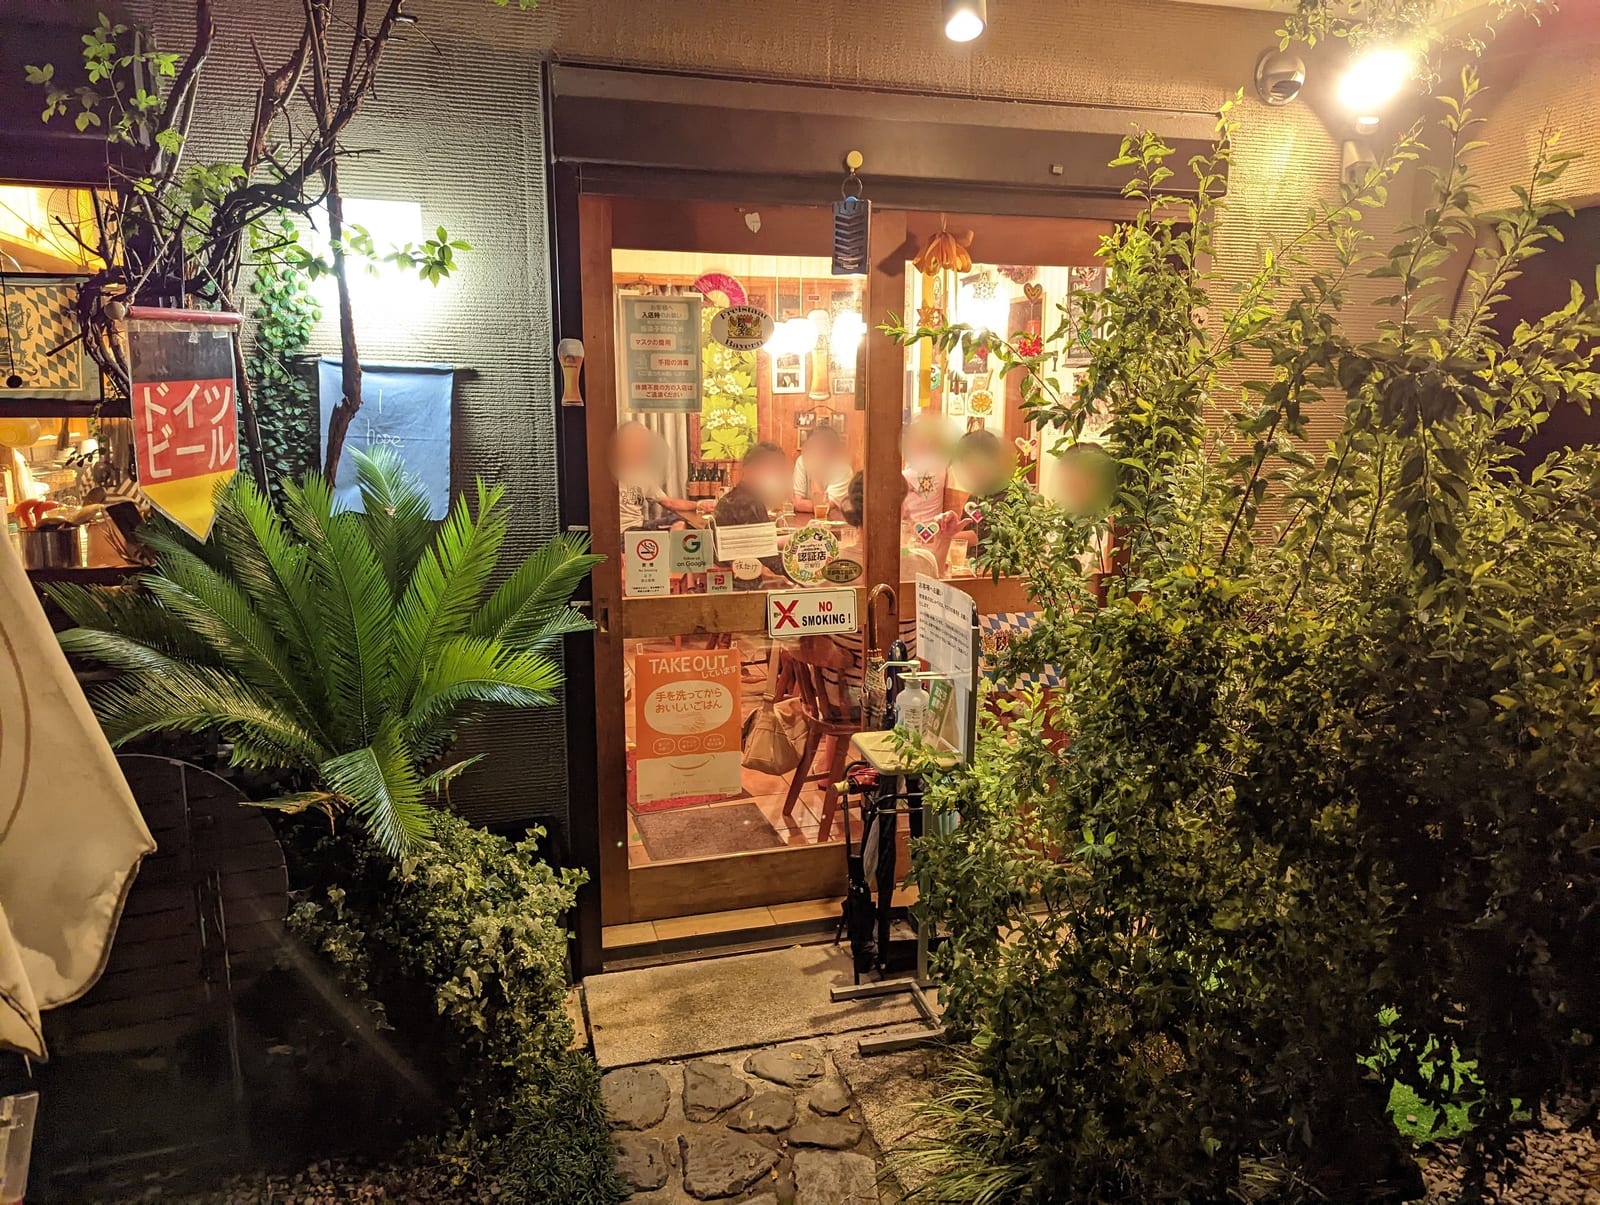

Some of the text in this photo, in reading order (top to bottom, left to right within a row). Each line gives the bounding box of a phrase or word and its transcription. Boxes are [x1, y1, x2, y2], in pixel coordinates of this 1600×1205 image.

[725, 338, 763, 350] Bayern
[143, 382, 231, 432] ドイツ
[147, 423, 234, 480] ビール
[797, 551, 827, 562] 認証店
[685, 560, 707, 568] Google
[818, 601, 833, 612] NO
[801, 614, 846, 627] SMOKING
[649, 655, 729, 674] TAKE OUT
[701, 665, 738, 679] しています
[656, 688, 722, 702] 手を洗ってから
[655, 700, 723, 714] おいしいごはん
